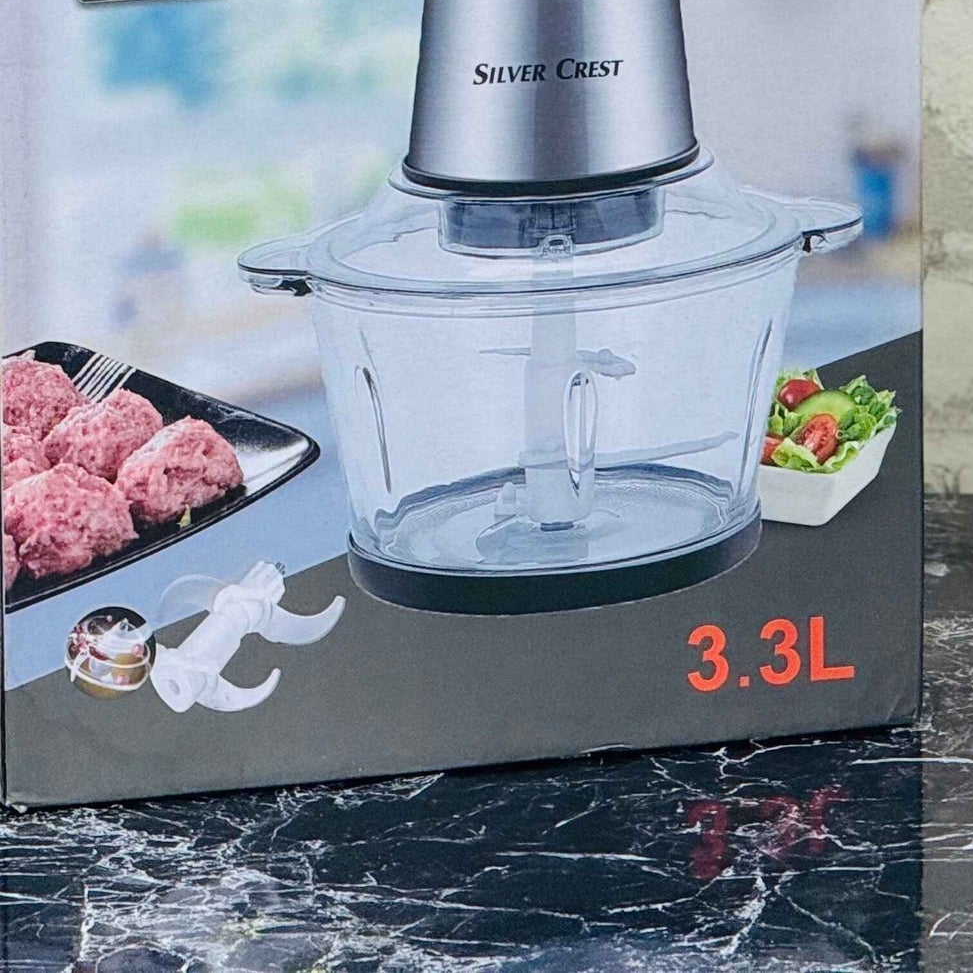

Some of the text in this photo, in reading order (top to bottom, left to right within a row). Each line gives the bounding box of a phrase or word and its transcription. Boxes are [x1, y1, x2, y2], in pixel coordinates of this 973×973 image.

[472, 58, 624, 85] SILVER CREST
[687, 615, 855, 692] 3.3L
